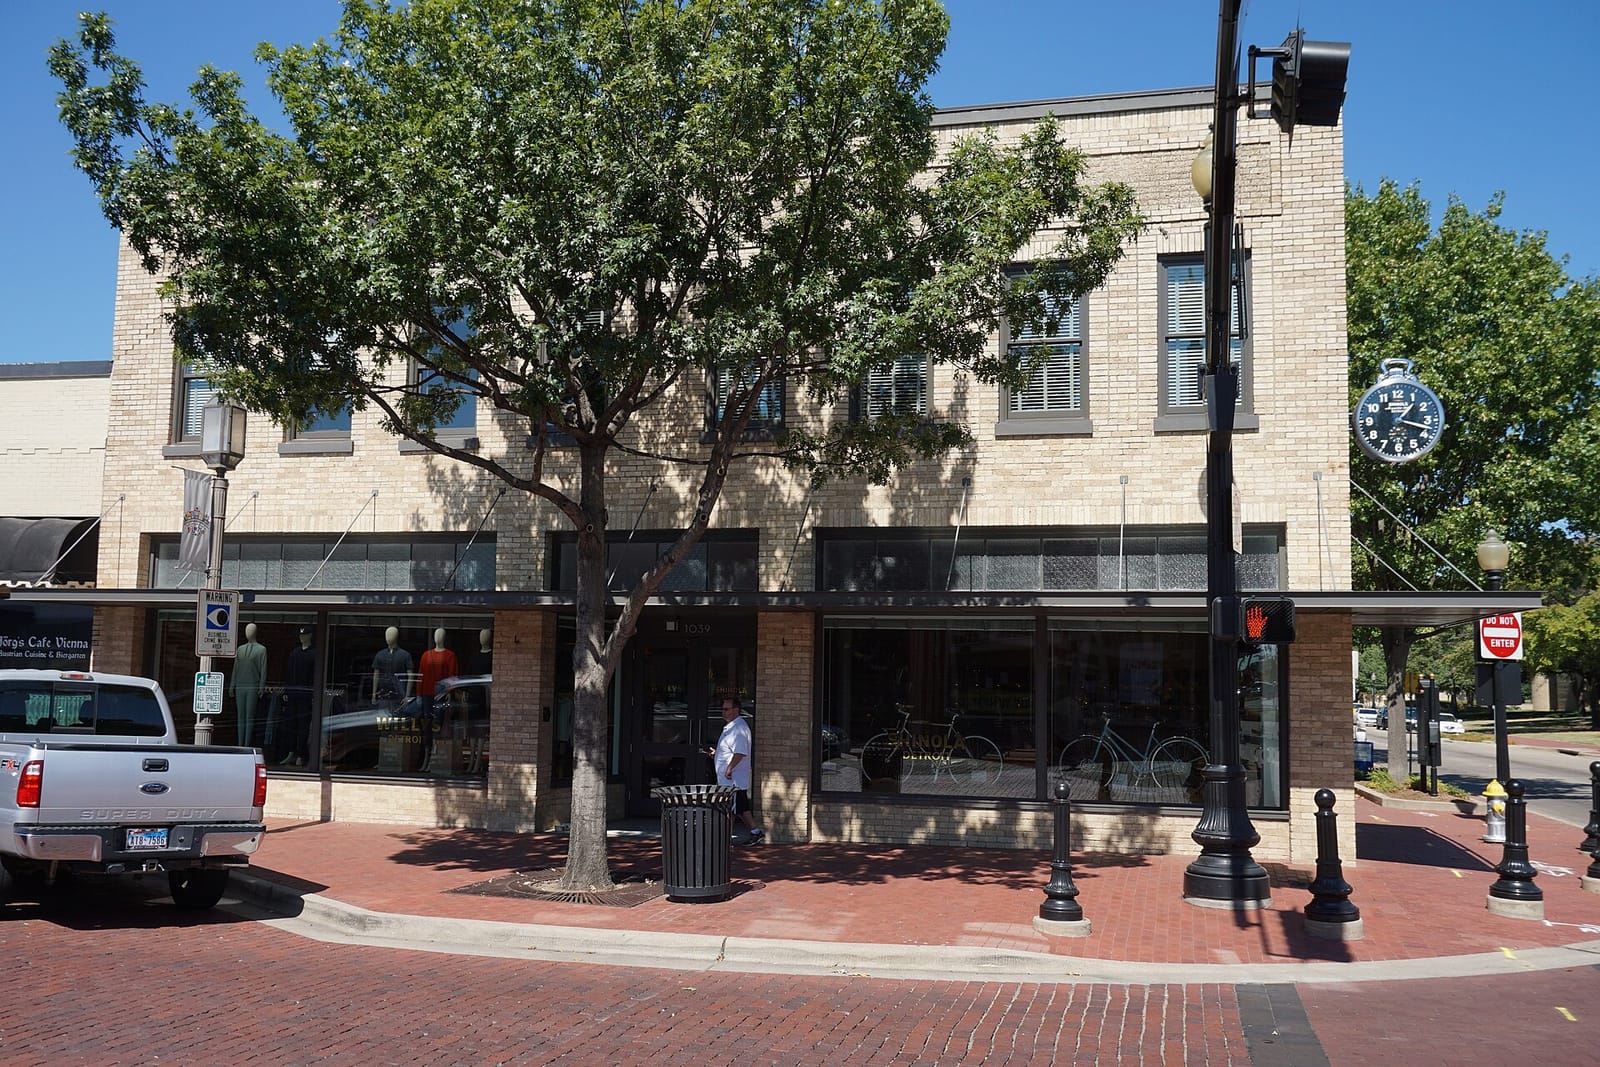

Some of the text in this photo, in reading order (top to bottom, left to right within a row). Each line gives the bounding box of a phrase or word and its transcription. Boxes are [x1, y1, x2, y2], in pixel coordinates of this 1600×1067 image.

[1379, 394, 1388, 402] 11
[1392, 390, 1404, 398] 12
[1410, 393, 1415, 402] 1
[1368, 404, 1379, 412] 10
[1420, 402, 1428, 412] 2
[1366, 417, 1374, 426] 9
[1424, 416, 1432, 424] 3
[1370, 430, 1378, 440] 8
[1420, 430, 1428, 438] 4
[1380, 440, 1388, 448] 7
[1394, 444, 1402, 452] 6
[1410, 440, 1418, 448] 5
[206, 591, 232, 603] WARNING
[1486, 616, 1514, 625] DO NOT
[684, 624, 711, 634] 1039
[28, 636, 52, 648] Cafe
[56, 636, 88, 648] Vienna
[1491, 638, 1514, 648] ENTER
[56, 651, 86, 660] Biergarten
[198, 676, 204, 684] 4
[888, 732, 966, 750] SHINOLA
[1, 759, 21, 770] FX4
[80, 808, 218, 820] SUPER DUTY
